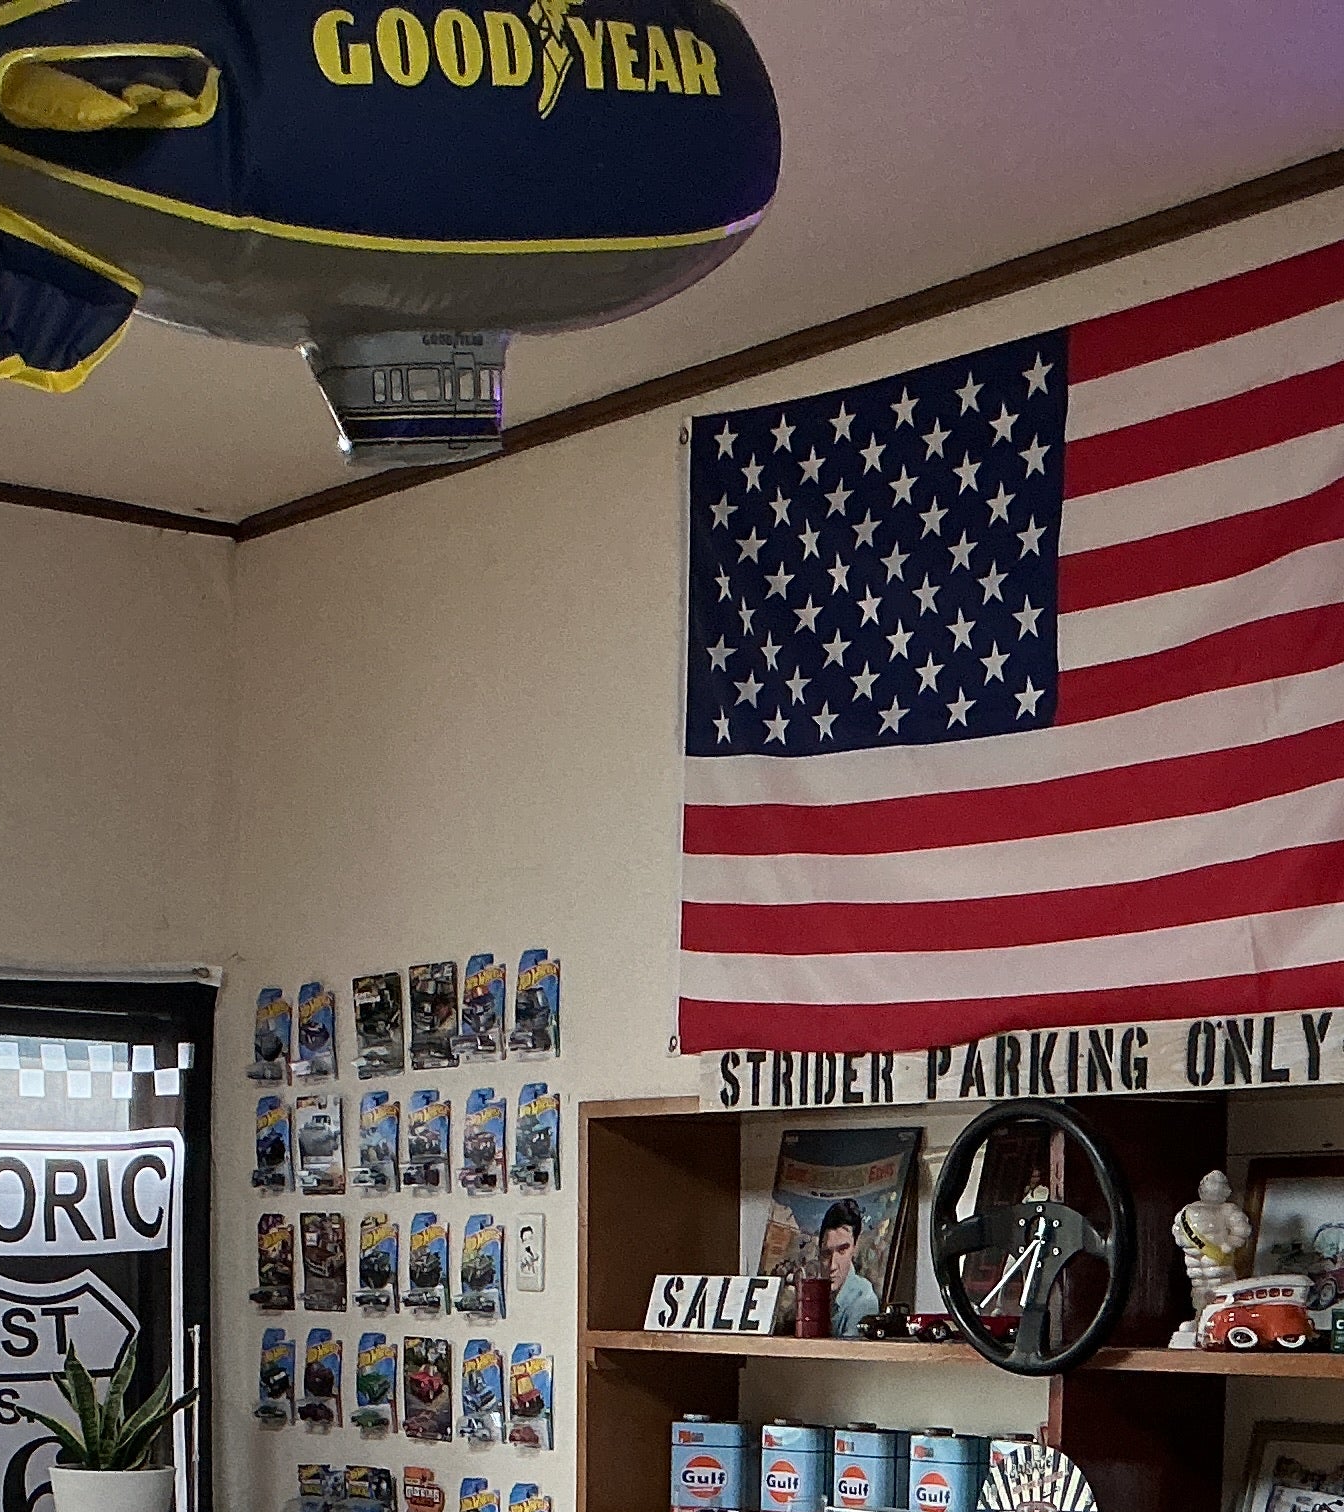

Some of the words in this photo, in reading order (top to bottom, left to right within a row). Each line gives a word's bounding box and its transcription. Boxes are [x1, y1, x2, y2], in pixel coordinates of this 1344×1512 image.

[719, 1050, 895, 1107] STRIDER
[927, 1026, 1149, 1099] PARKING
[658, 1275, 768, 1331] SALE
[681, 1468, 727, 1485] Gulf
[766, 1473, 799, 1491] Gulf
[838, 1478, 869, 1497] Gulf
[916, 1487, 951, 1505] Gulf
